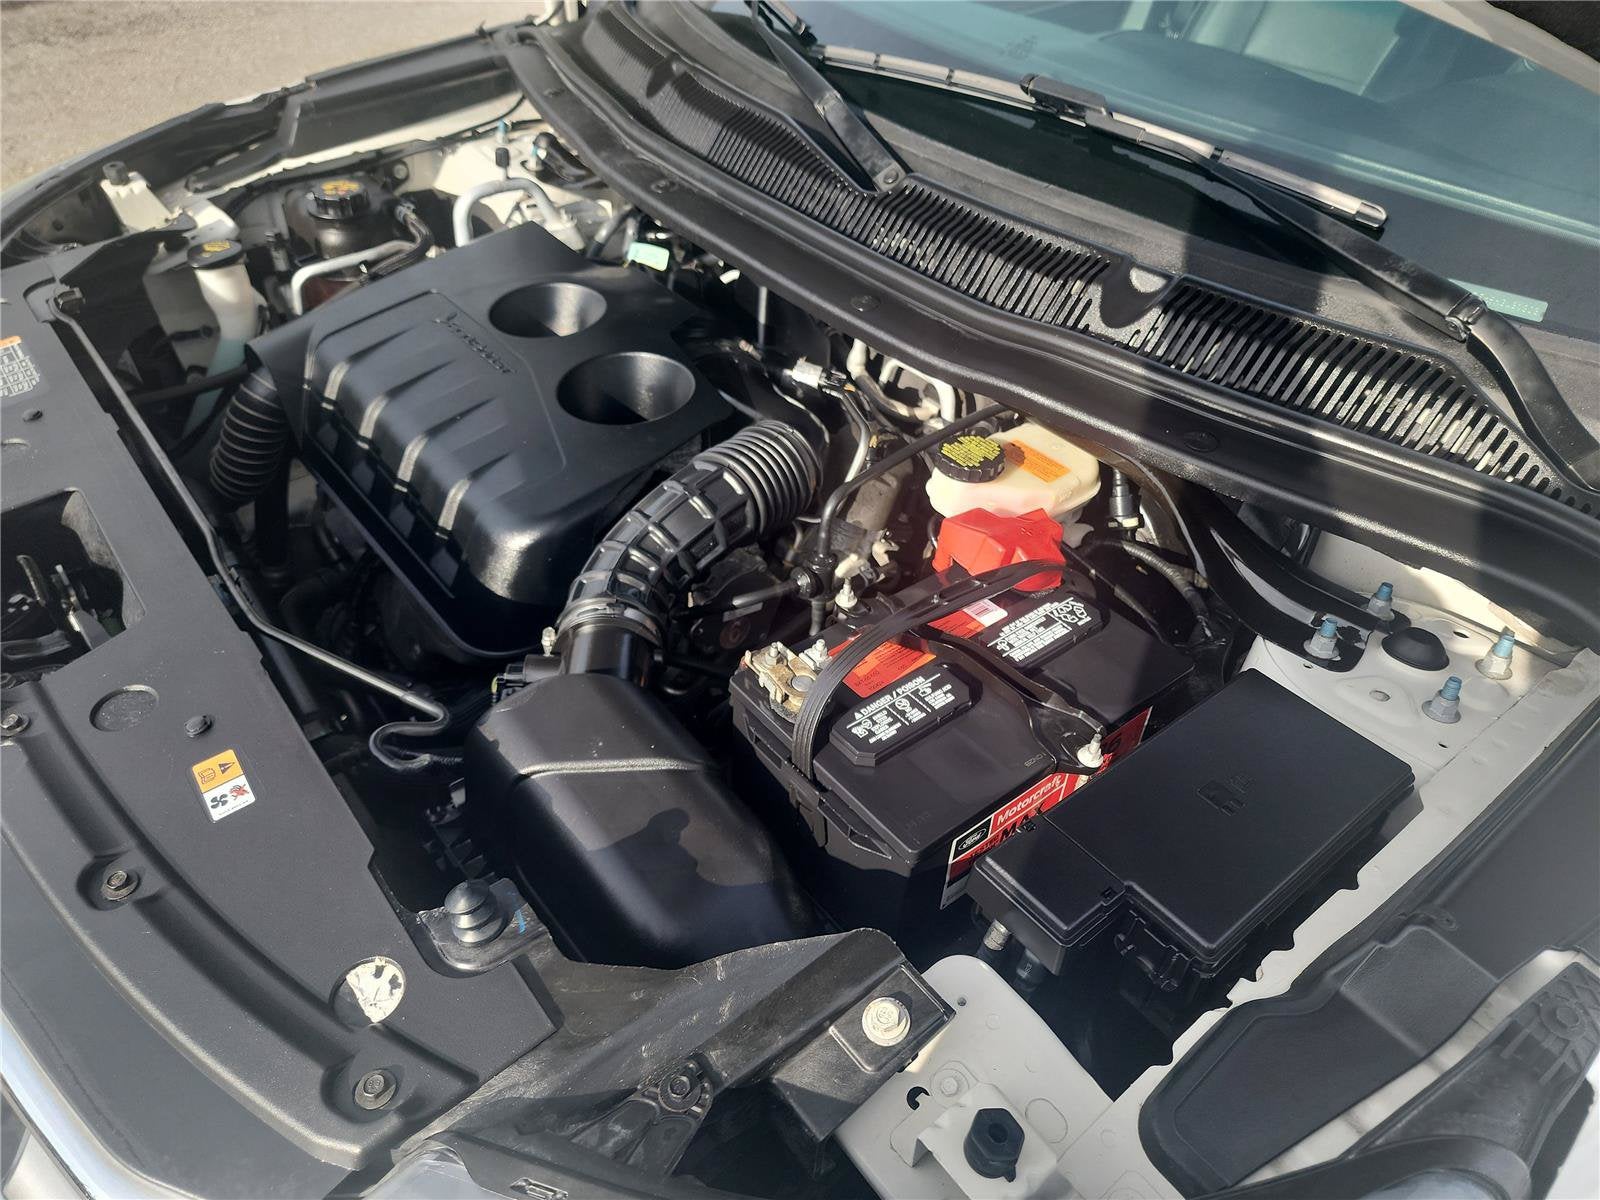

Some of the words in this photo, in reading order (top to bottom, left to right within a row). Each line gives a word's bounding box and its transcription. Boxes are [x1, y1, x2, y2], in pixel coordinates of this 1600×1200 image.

[860, 694, 893, 716] DANGER
[896, 676, 926, 695] POISON
[997, 774, 1062, 827] Motorcraft
